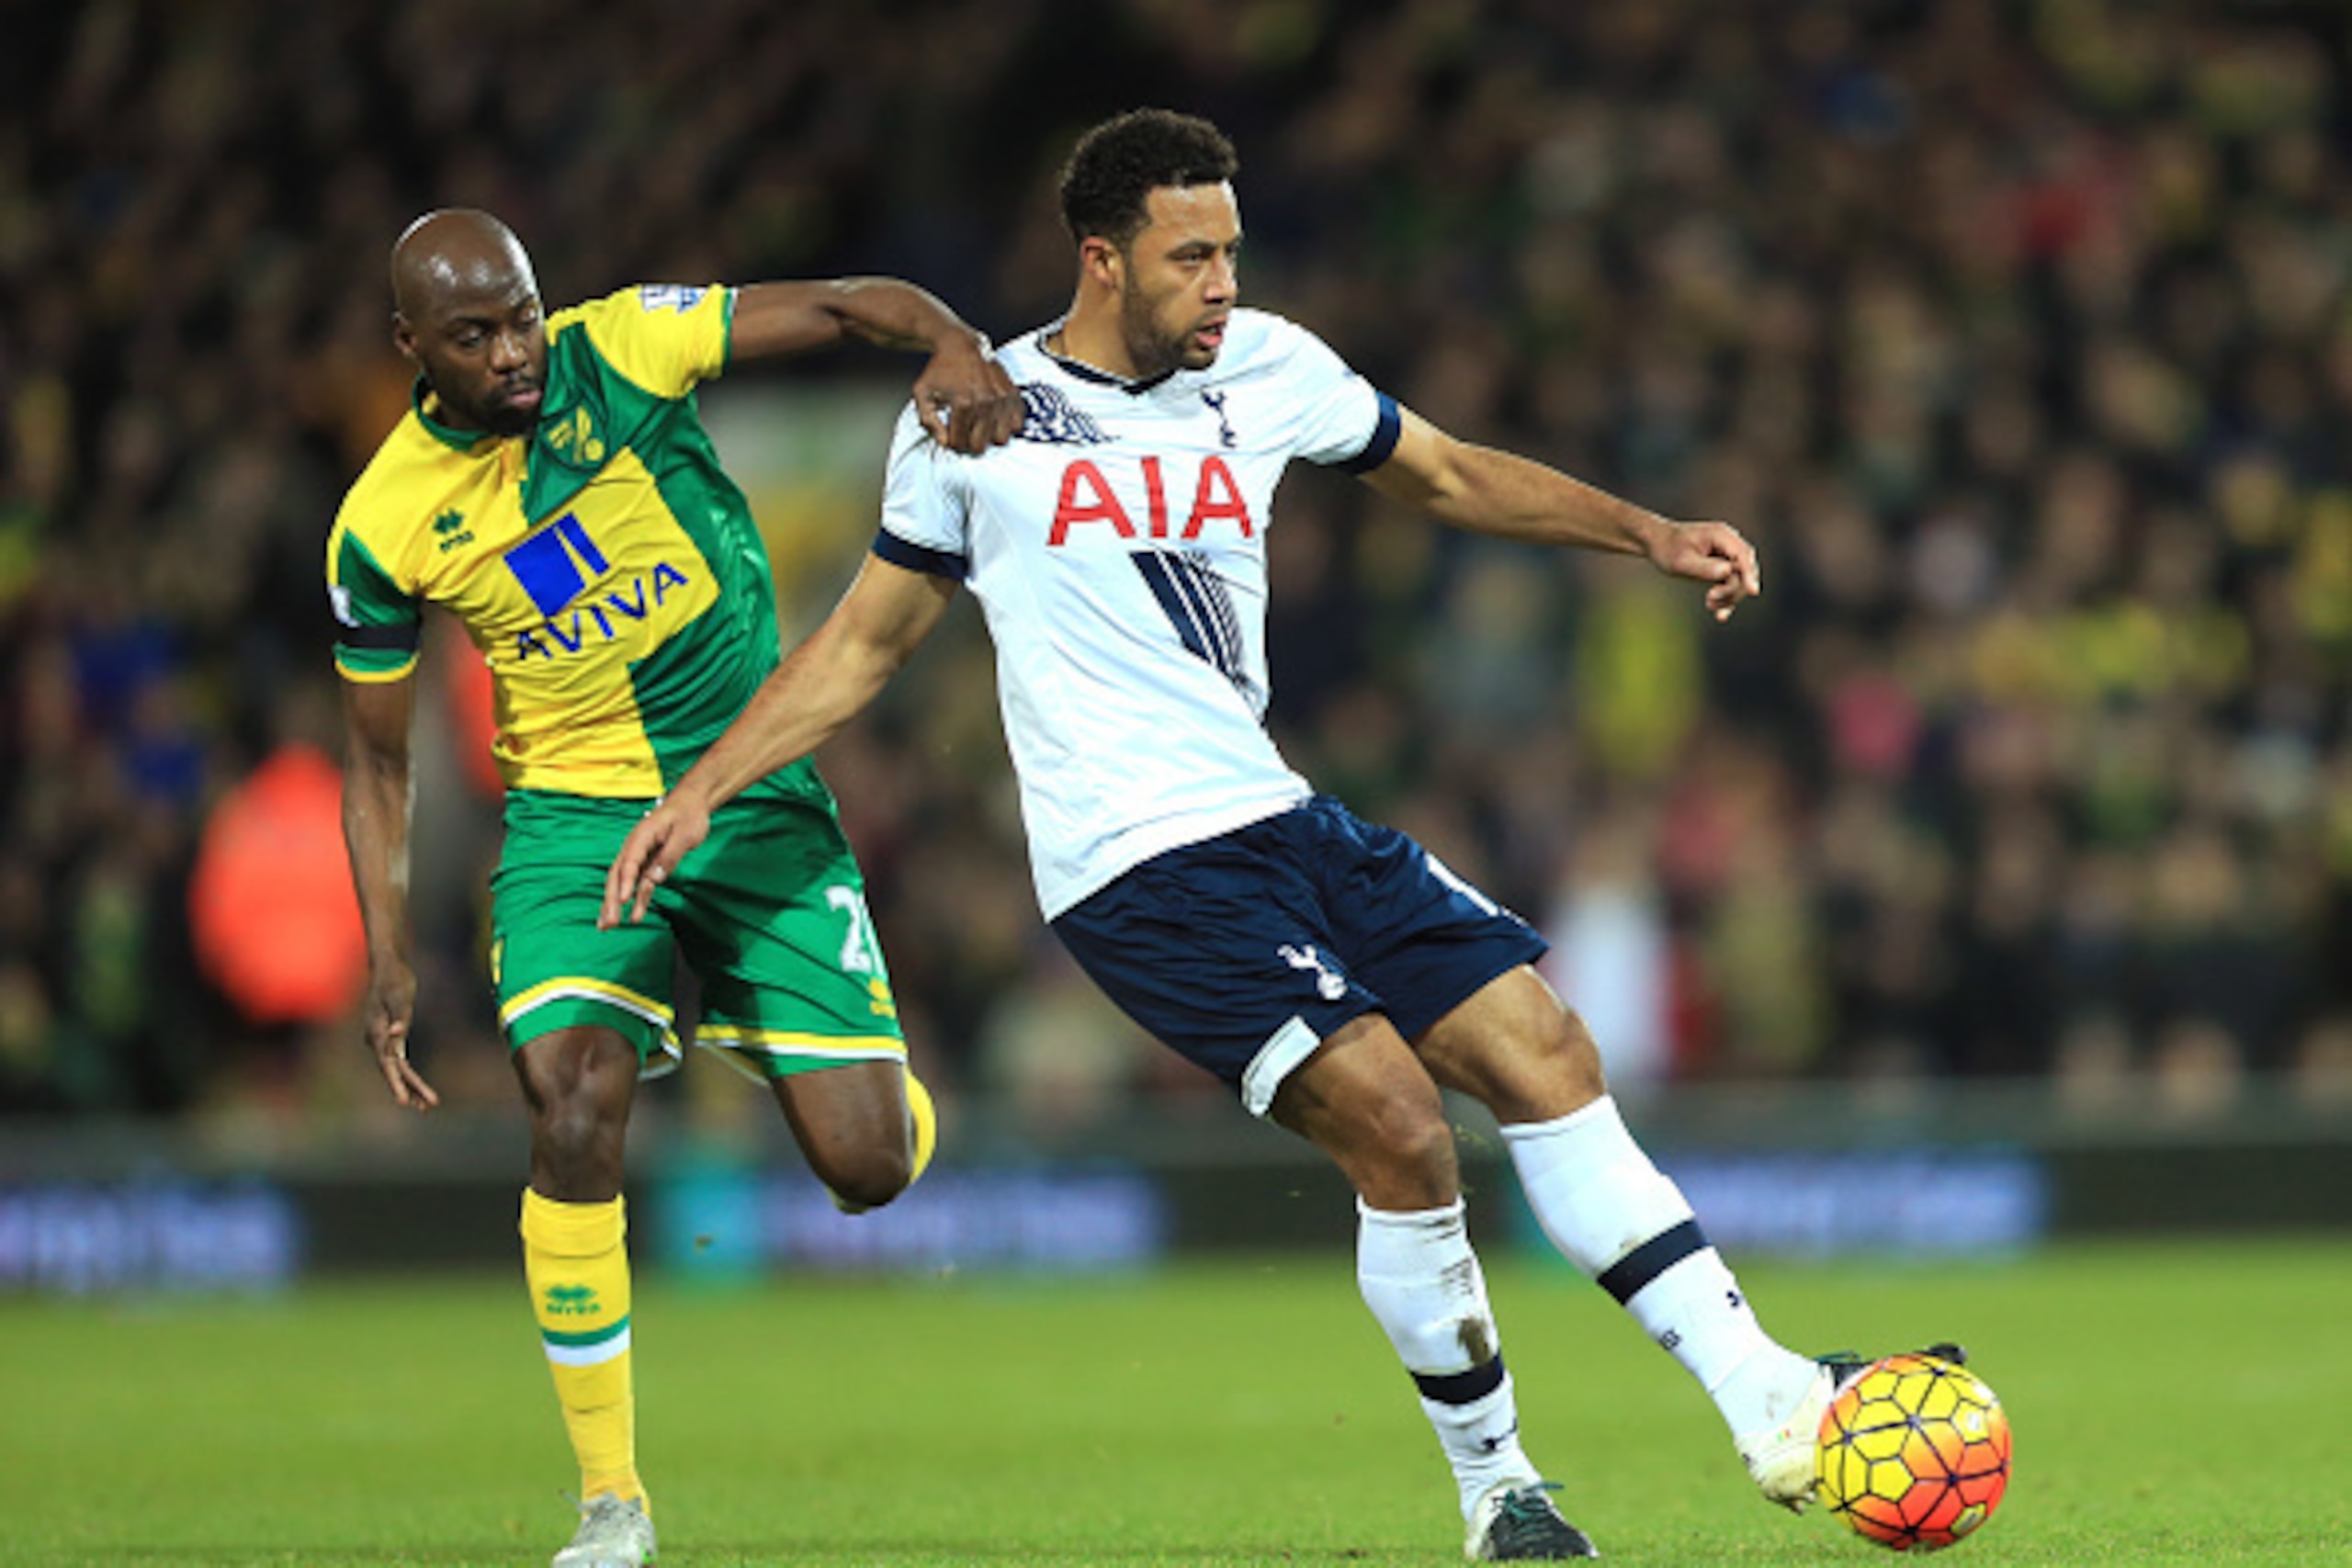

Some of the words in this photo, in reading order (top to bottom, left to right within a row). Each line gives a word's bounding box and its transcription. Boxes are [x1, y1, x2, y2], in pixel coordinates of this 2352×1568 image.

[1047, 456, 1254, 546] AIA
[517, 562, 688, 660] AVIVA
[824, 885, 887, 976] 2
